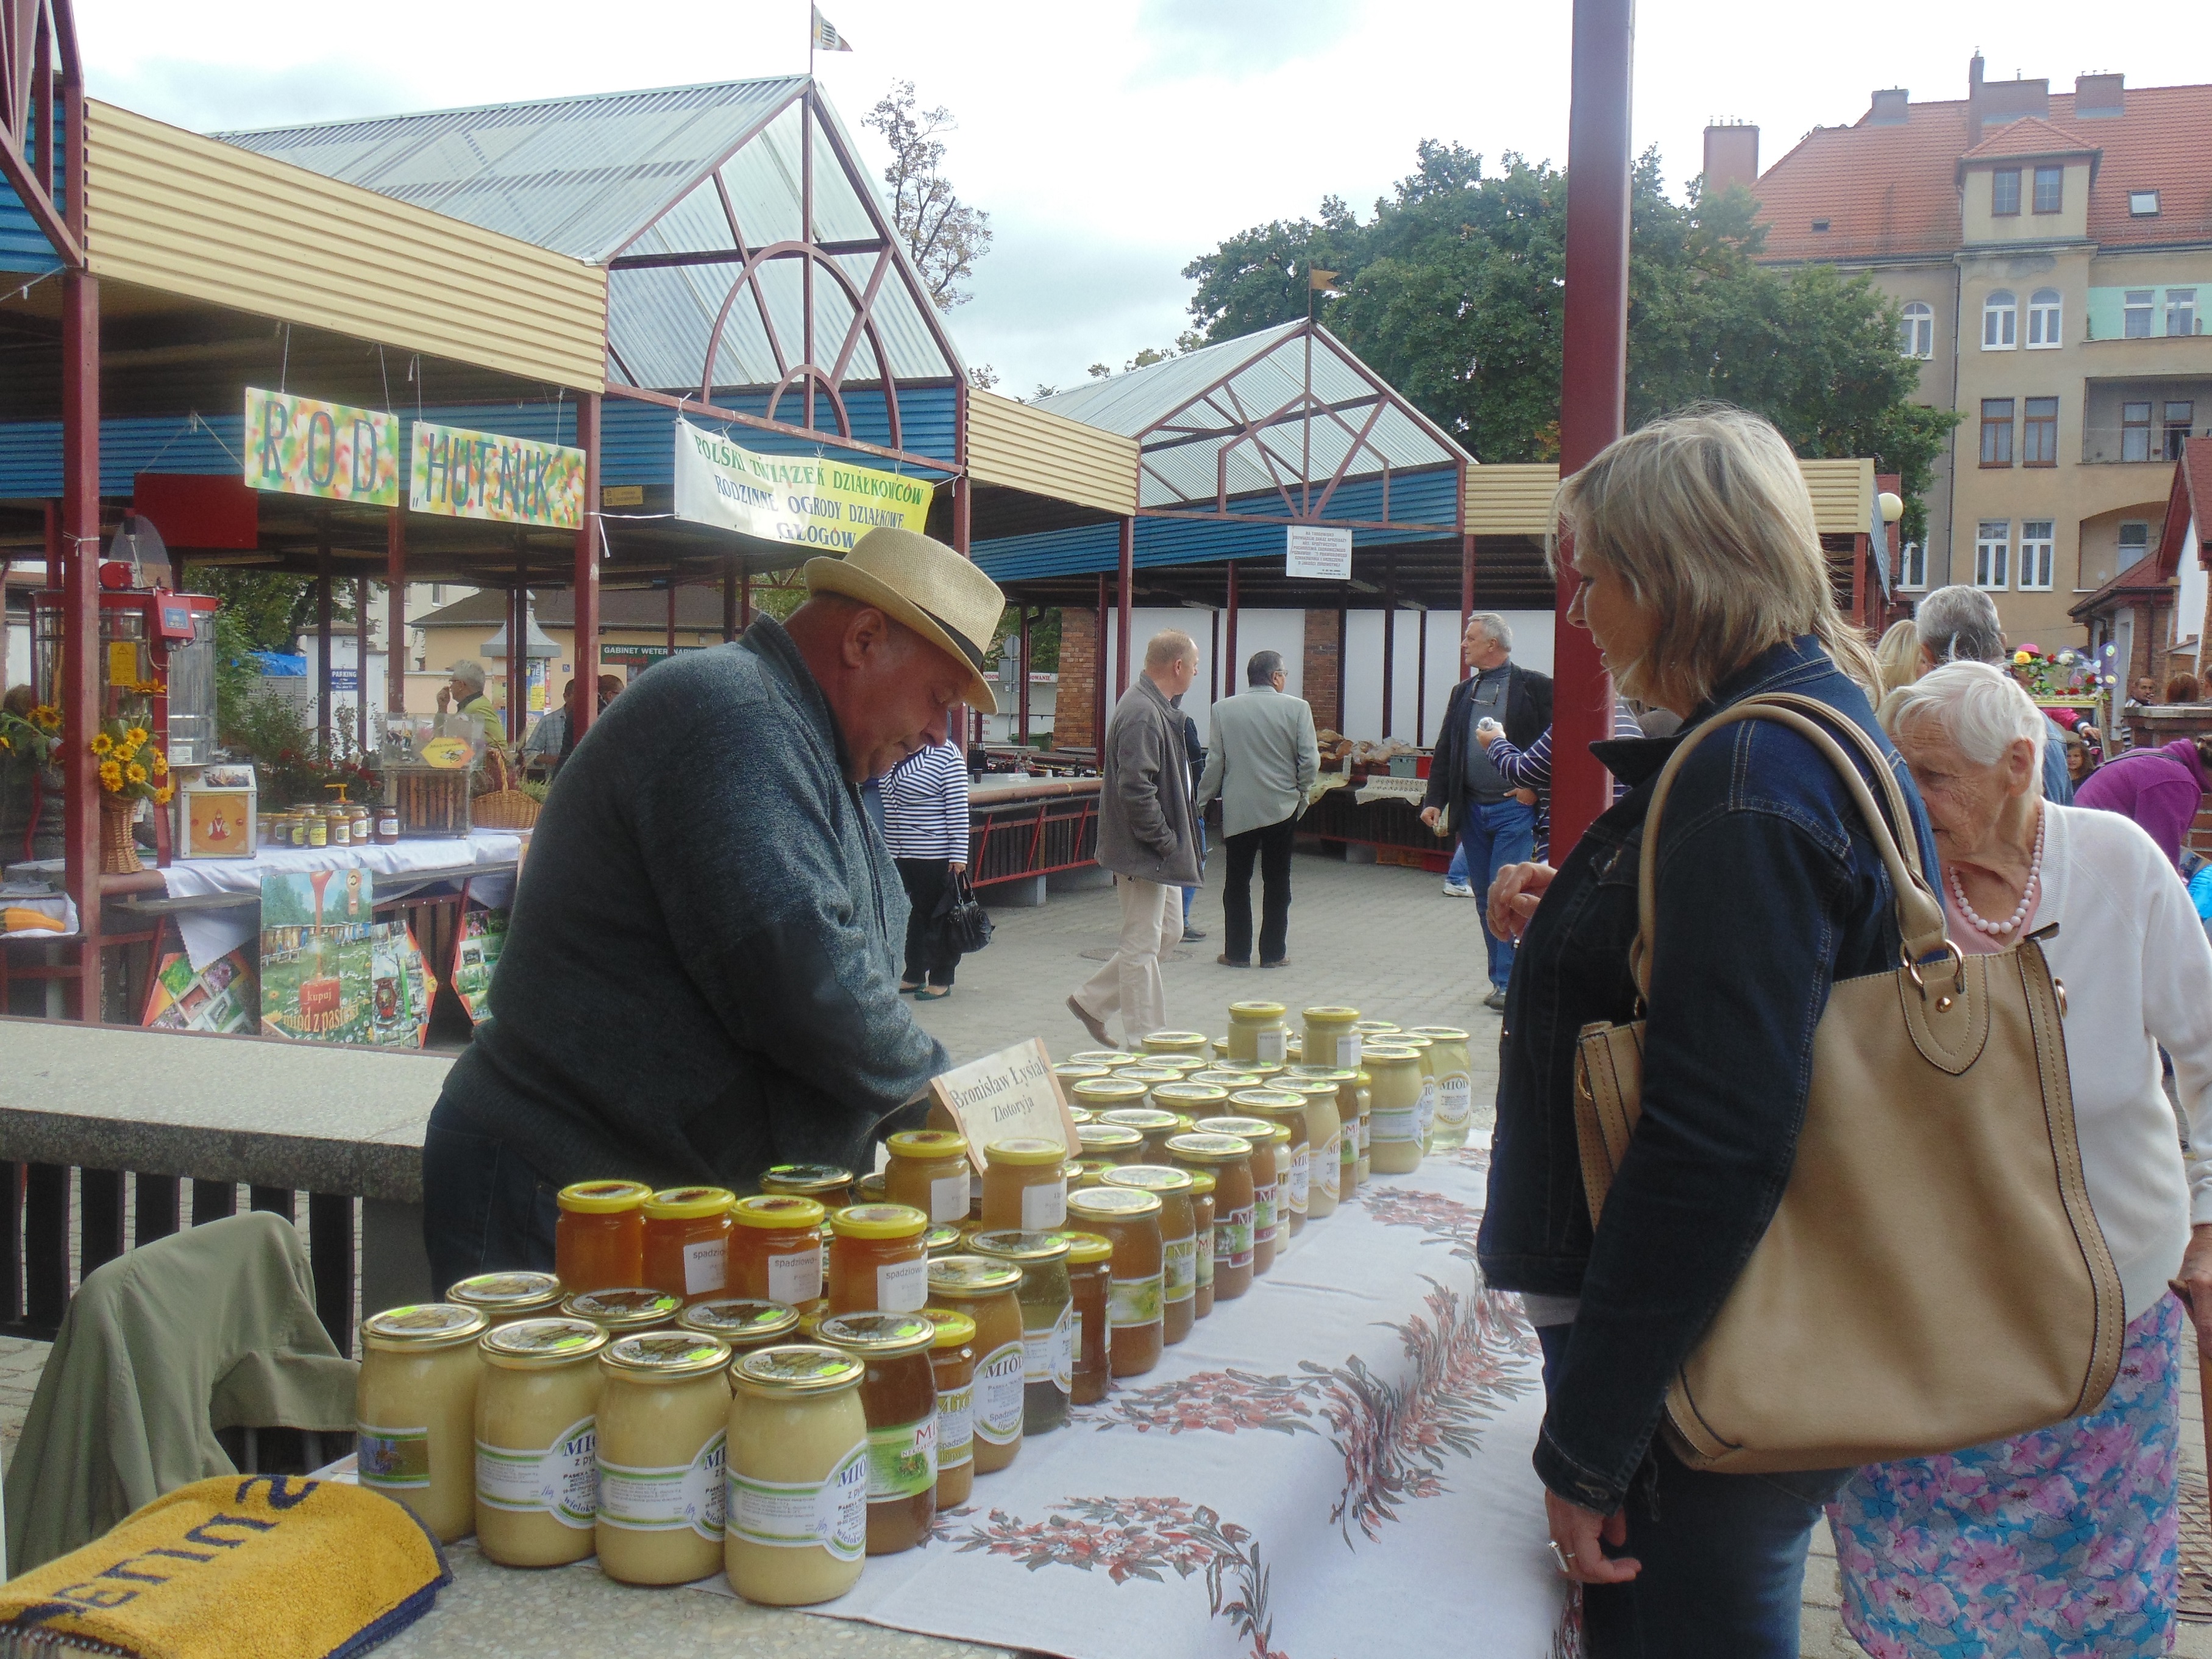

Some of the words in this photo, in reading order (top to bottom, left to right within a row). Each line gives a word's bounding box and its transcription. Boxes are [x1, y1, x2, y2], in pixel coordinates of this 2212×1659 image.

[262, 400, 377, 493] ROD
[694, 434, 744, 471] POLSKI
[834, 471, 924, 505] DZIAŁKOWCÓW
[714, 474, 778, 511] RODZINNE
[788, 496, 842, 522] OGRODY
[307, 989, 332, 1001] kupuj
[313, 1013, 319, 1032] z
[950, 1076, 1011, 1109] Bronisław
[1009, 1056, 1050, 1087] Łysiak
[991, 1095, 1034, 1123] Złotoryja
[563, 1435, 596, 1457] MI
[916, 1419, 937, 1446] MI
